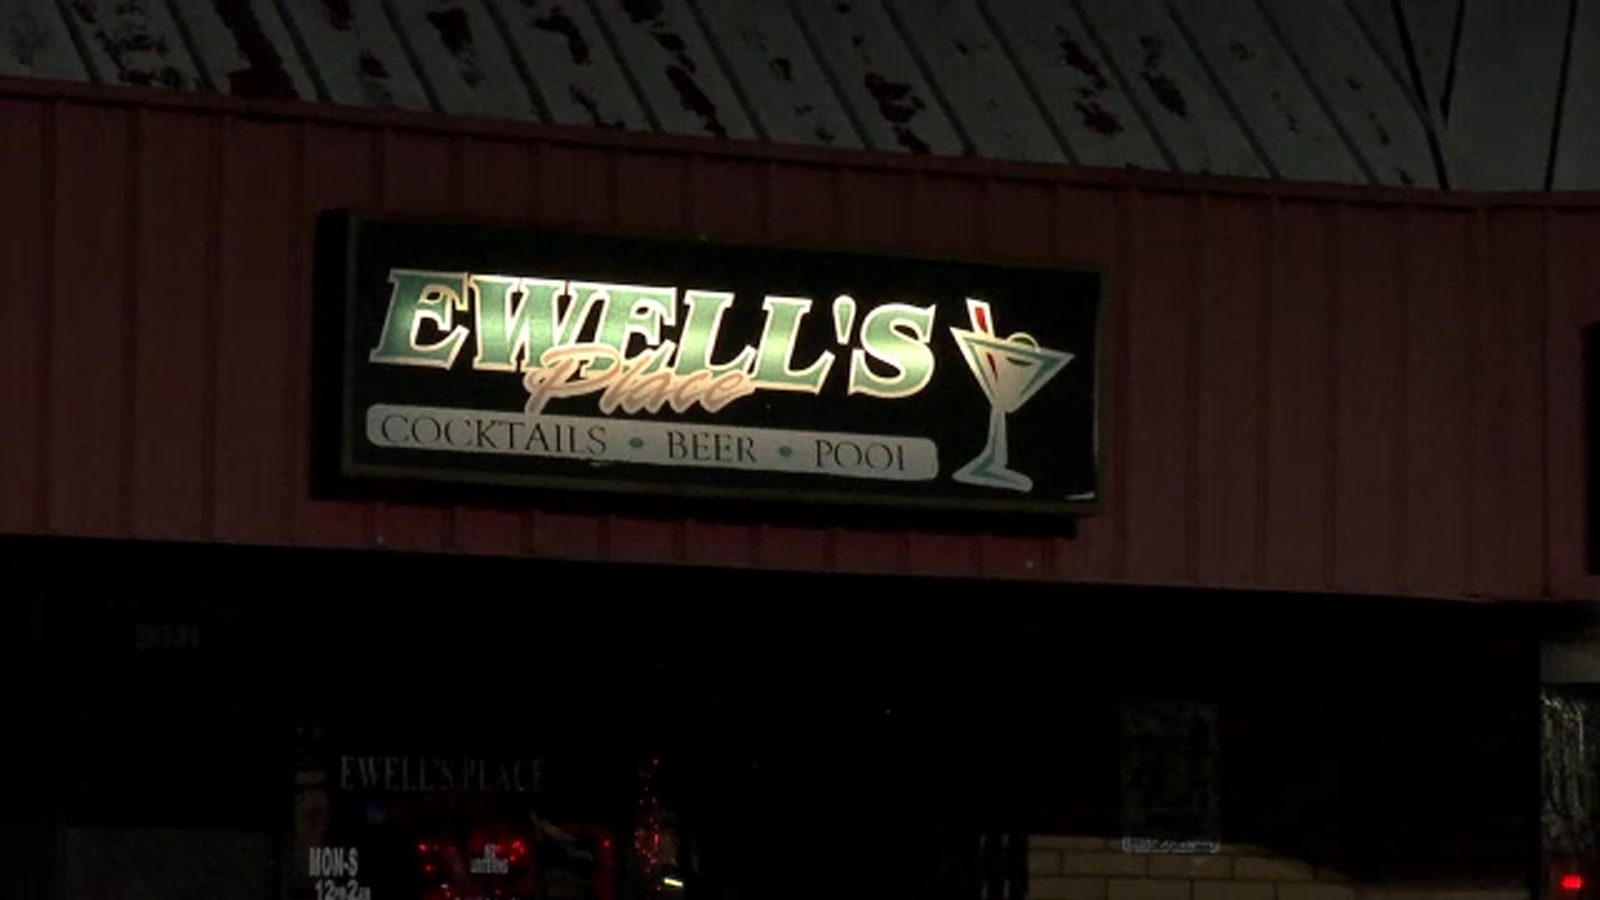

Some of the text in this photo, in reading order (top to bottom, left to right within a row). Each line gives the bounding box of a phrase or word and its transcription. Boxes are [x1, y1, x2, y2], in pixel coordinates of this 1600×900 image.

[369, 268, 936, 398] EWELL'S
[523, 344, 757, 415] Place
[380, 413, 608, 456] COCKTAILS
[667, 430, 758, 463] BEER
[339, 753, 547, 793] EWELL'S PLACE
